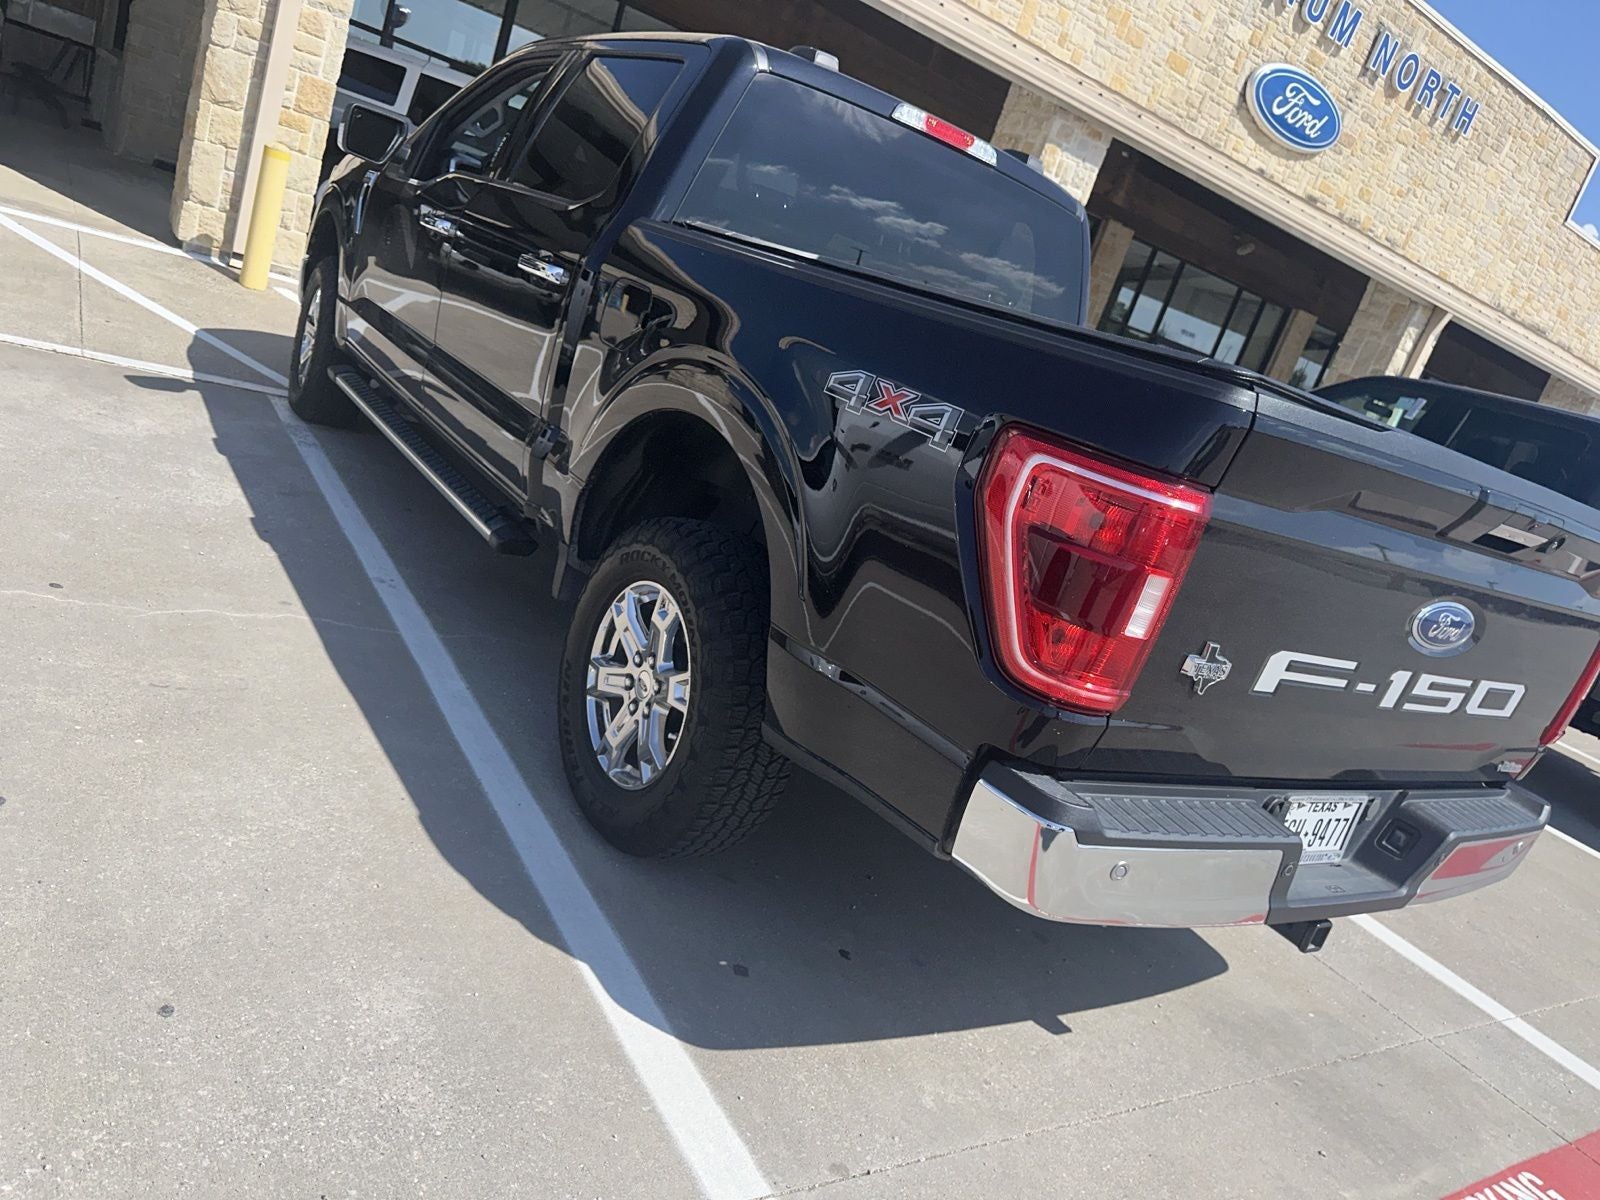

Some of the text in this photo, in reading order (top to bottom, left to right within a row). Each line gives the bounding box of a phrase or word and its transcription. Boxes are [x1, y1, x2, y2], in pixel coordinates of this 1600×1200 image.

[1287, 0, 1481, 136] UM NORTH
[1272, 82, 1328, 139] Ford
[1428, 612, 1466, 641] Ford
[1194, 661, 1229, 678] TEXAS
[1251, 650, 1526, 718] F-150
[1308, 801, 1339, 813] TEXAS
